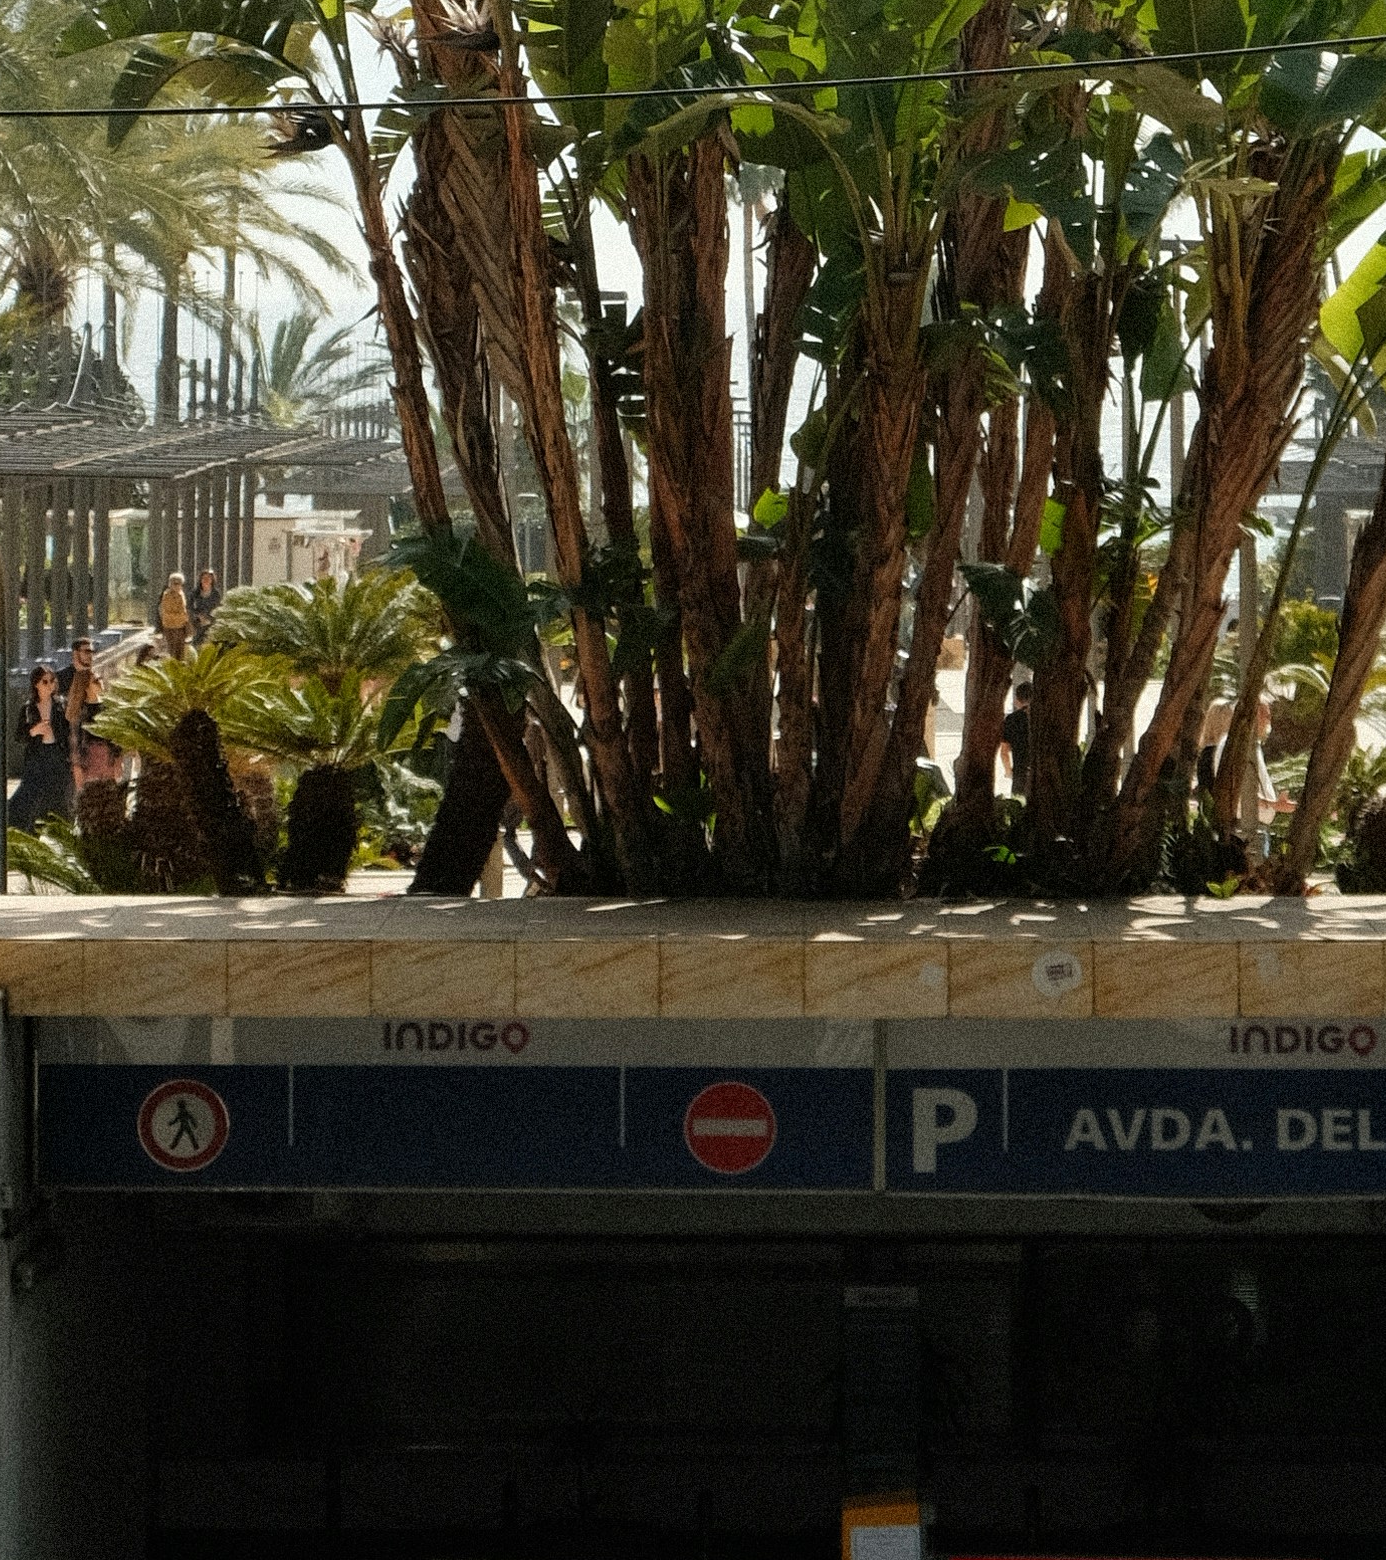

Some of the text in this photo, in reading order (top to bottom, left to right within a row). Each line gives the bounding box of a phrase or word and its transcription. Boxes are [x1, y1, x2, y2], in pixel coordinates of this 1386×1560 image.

[383, 1022, 529, 1054] INDIGO
[1229, 1024, 1378, 1056] INDIGO
[912, 1087, 979, 1174] P
[1063, 1109, 1254, 1152] AVDA.
